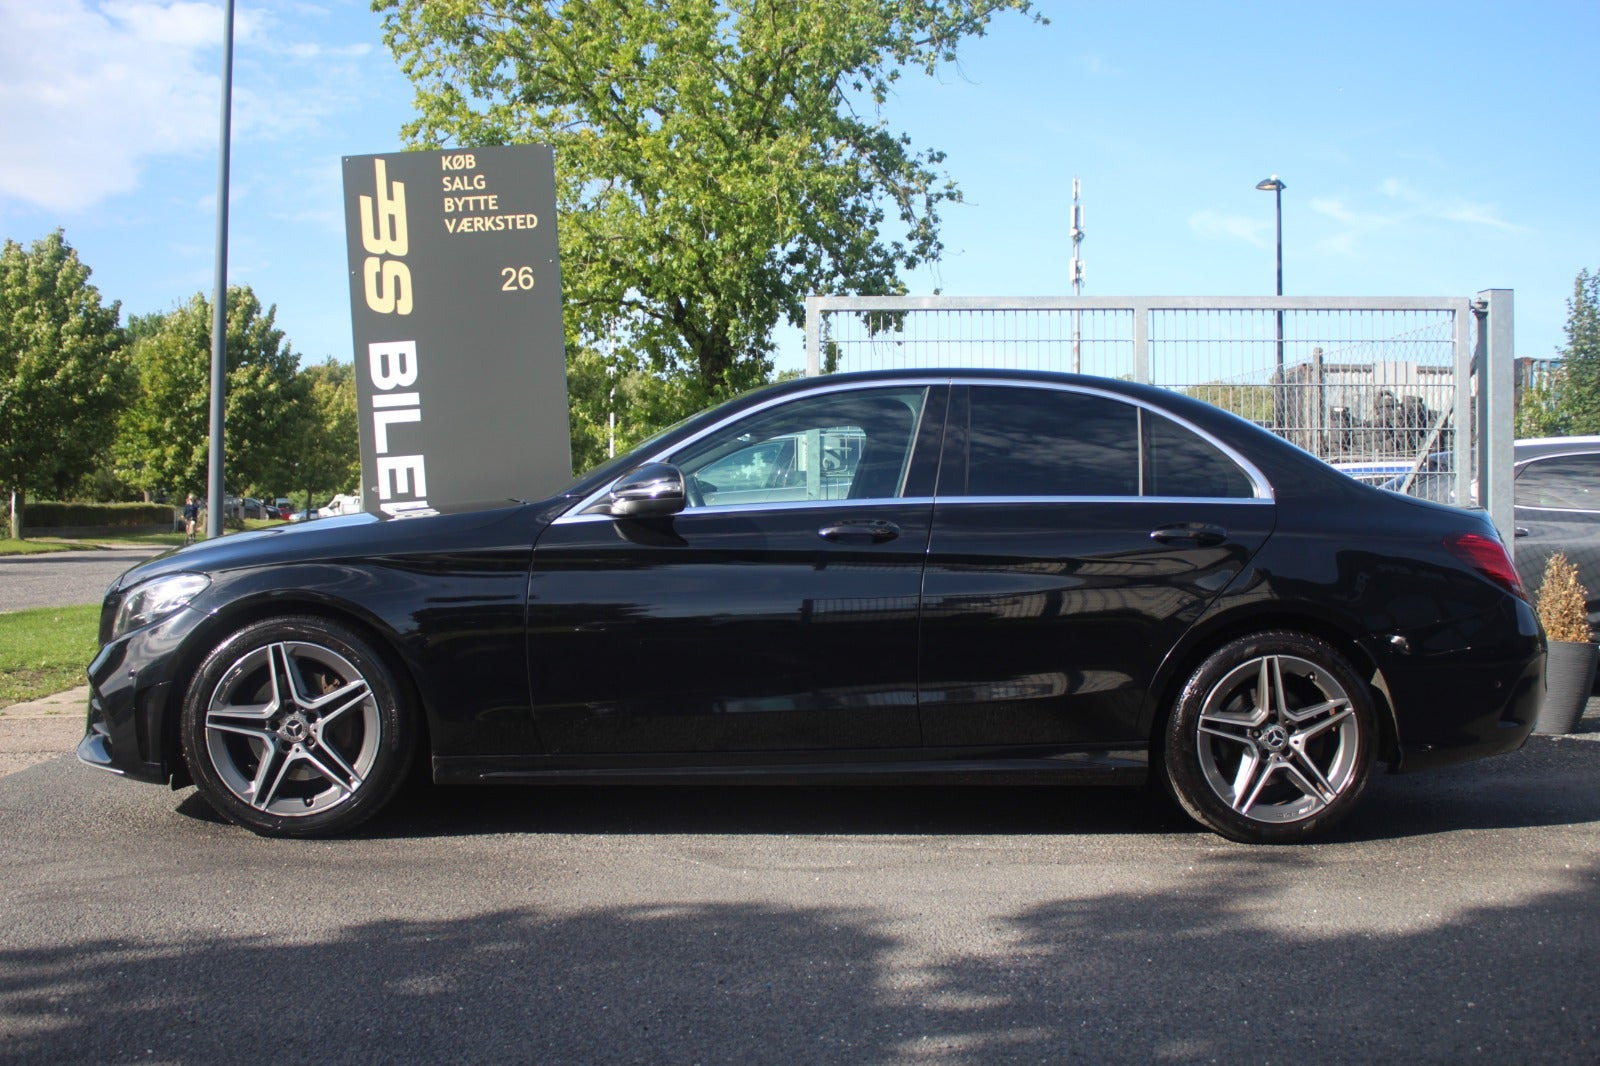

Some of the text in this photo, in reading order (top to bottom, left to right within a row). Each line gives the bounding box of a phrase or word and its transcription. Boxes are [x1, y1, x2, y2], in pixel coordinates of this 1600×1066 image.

[441, 154, 476, 171] KØB
[442, 174, 486, 192] SALG
[444, 194, 499, 213] BYTTE
[444, 213, 538, 234] VÆRKSTED
[501, 266, 535, 291] 26
